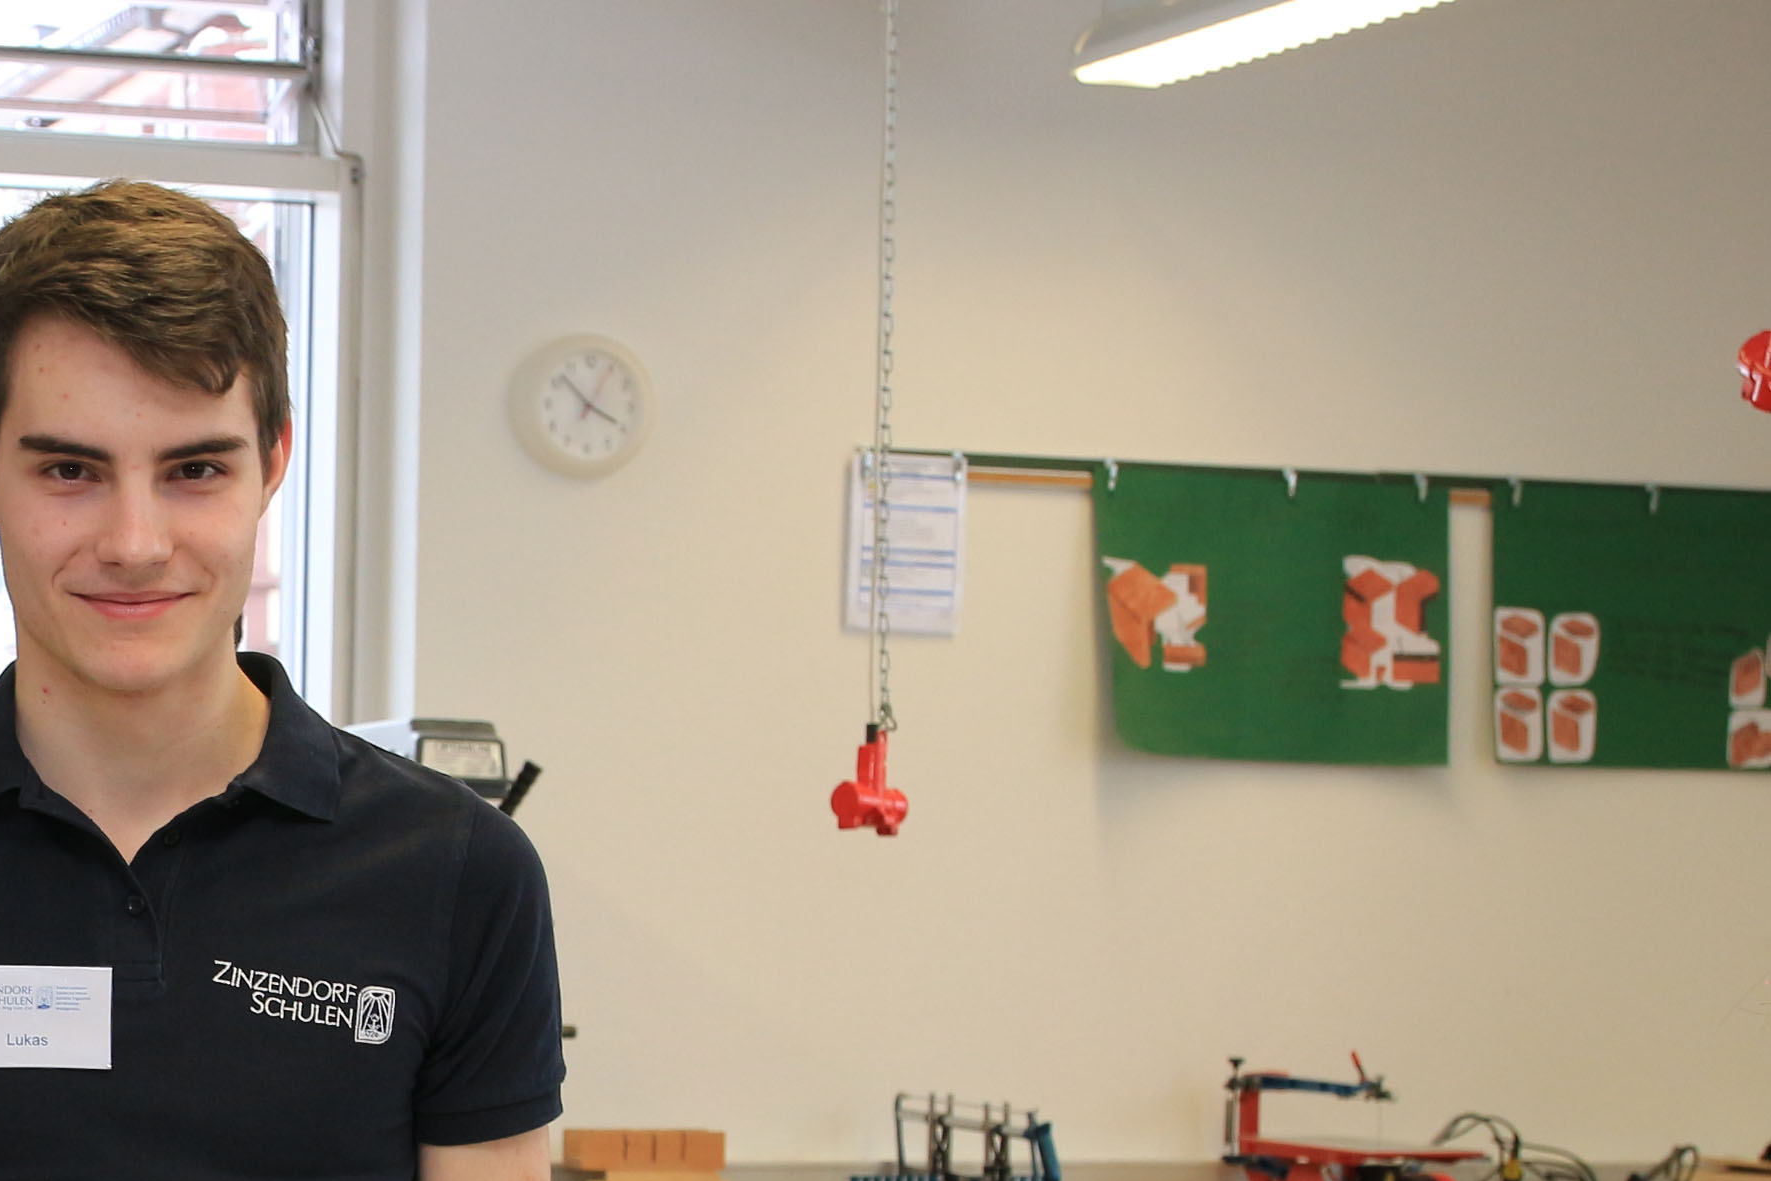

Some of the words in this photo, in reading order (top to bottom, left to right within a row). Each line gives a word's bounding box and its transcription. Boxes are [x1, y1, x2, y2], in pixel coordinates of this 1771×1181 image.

[213, 960, 358, 1003] ZINZENDORF
[249, 991, 354, 1029] SCHULEN
[6, 1033, 49, 1047] Lukas
